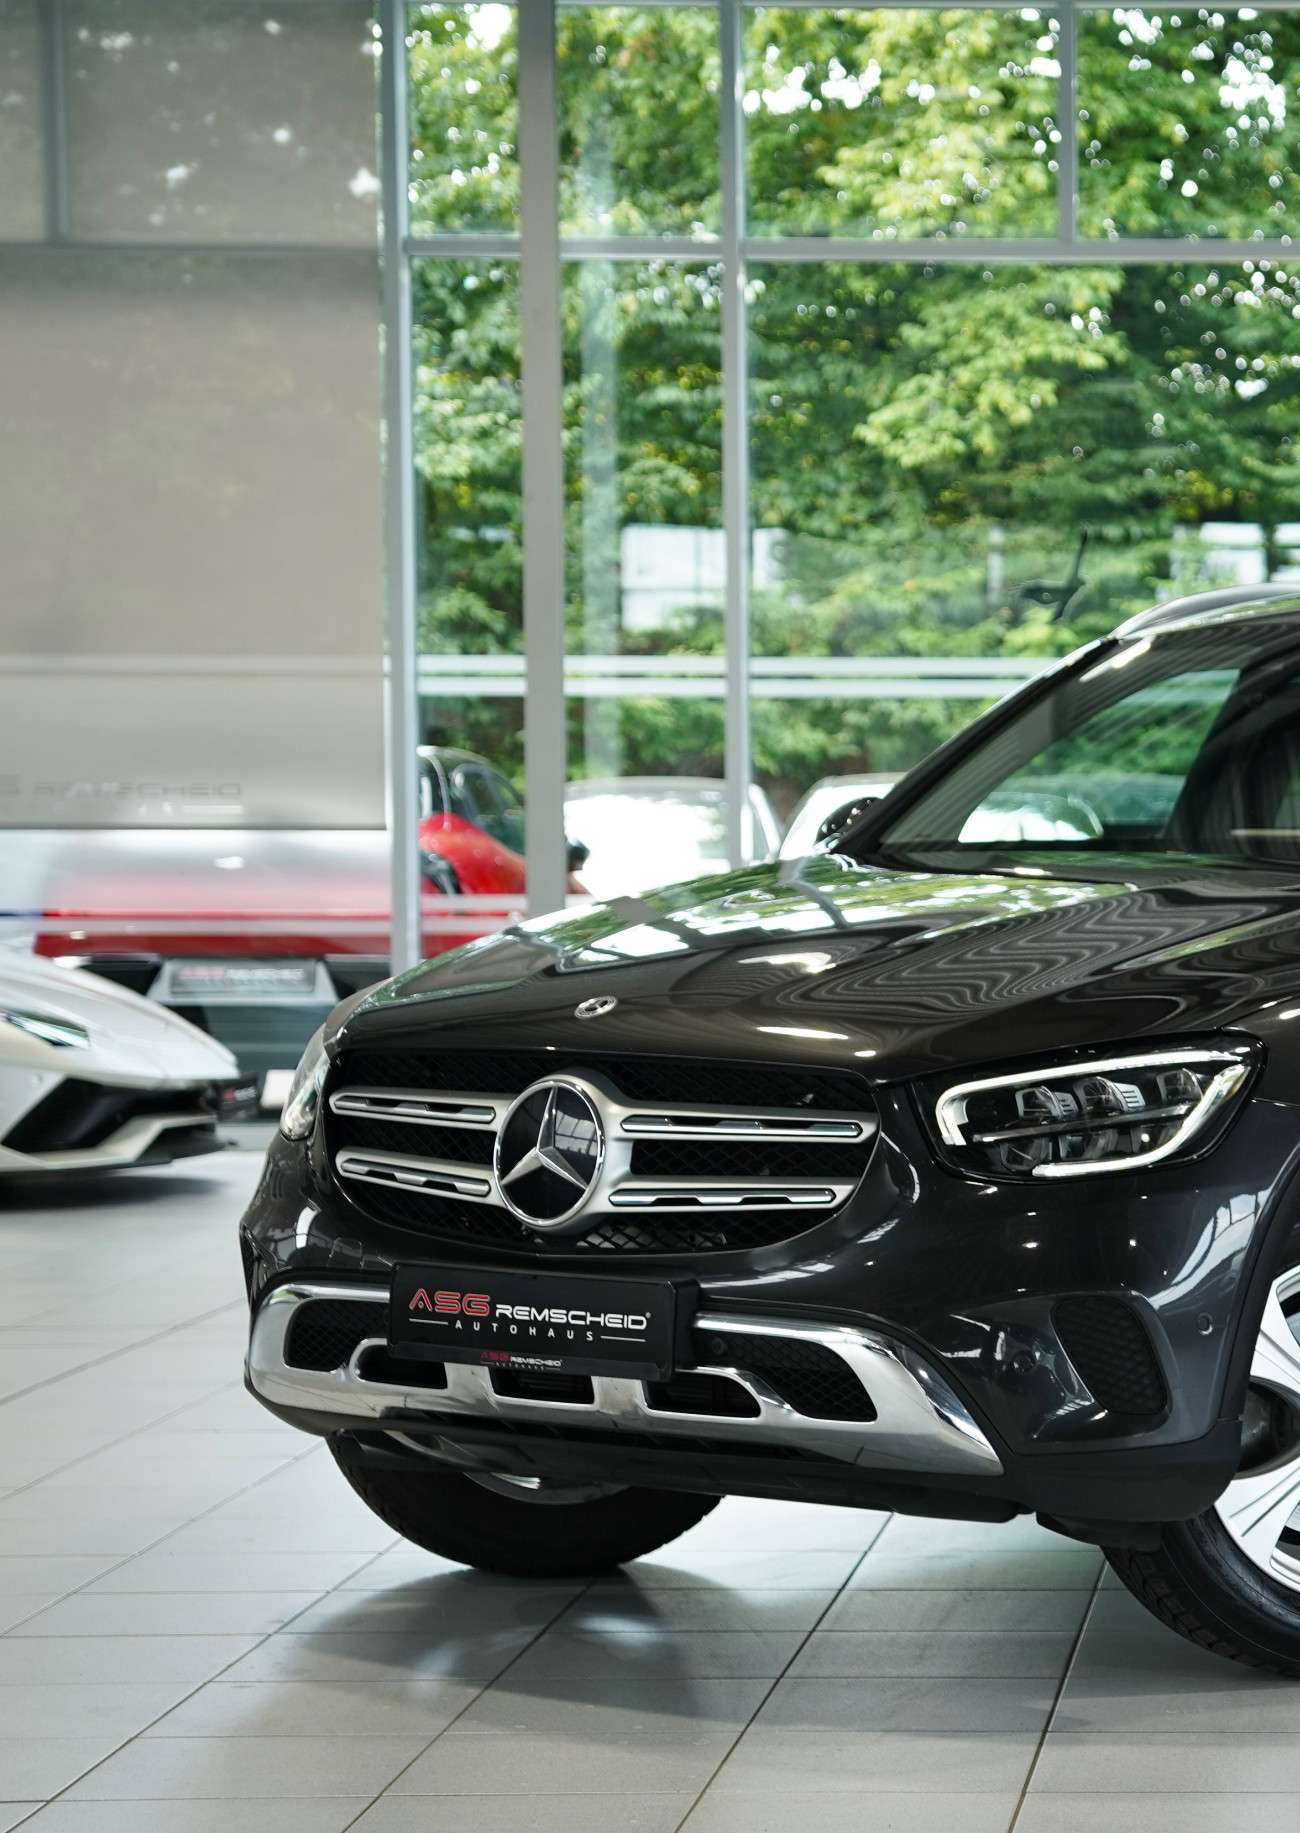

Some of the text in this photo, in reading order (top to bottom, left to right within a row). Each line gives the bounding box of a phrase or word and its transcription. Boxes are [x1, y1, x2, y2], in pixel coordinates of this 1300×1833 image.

[408, 1288, 647, 1330] ASG REMSCHEID
[454, 1319, 594, 1342] AUTOHAUS
